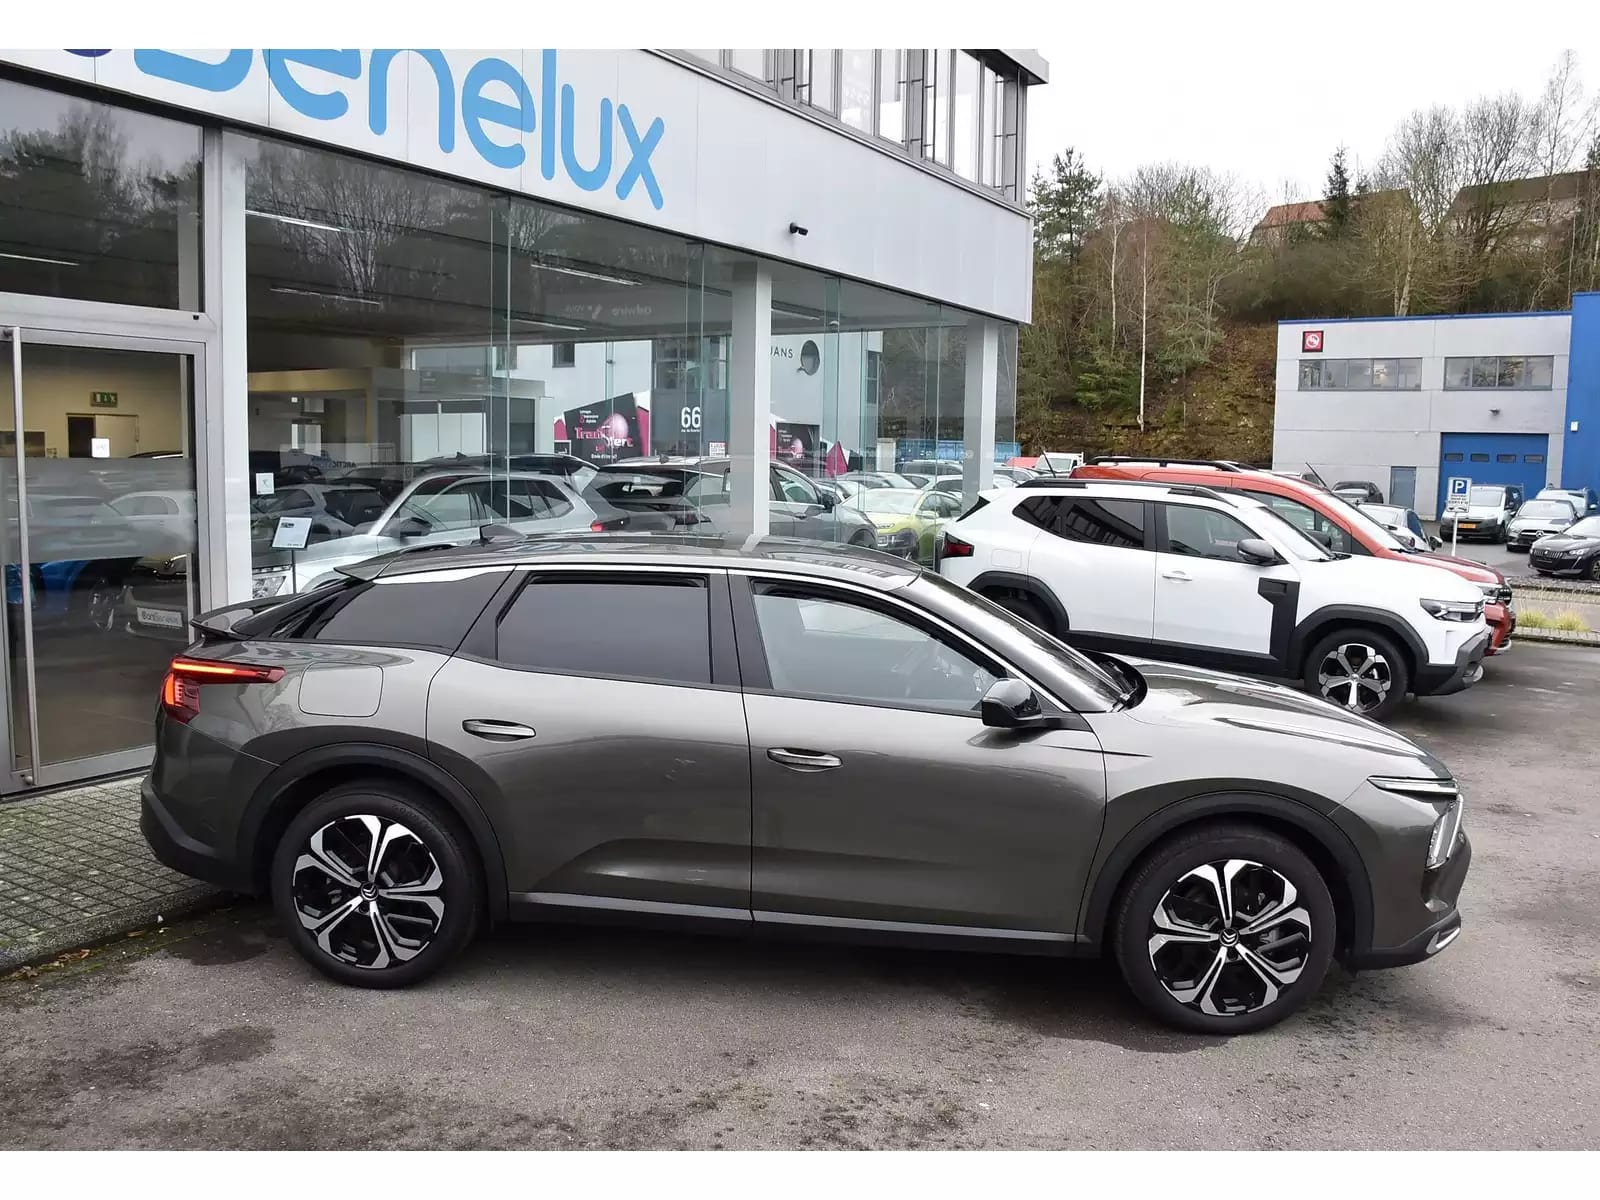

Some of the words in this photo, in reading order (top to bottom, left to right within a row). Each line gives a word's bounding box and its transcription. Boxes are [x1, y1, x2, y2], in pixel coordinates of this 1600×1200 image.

[134, 49, 664, 210] enelux
[681, 406, 701, 428] 66
[1454, 480, 1465, 493] P
